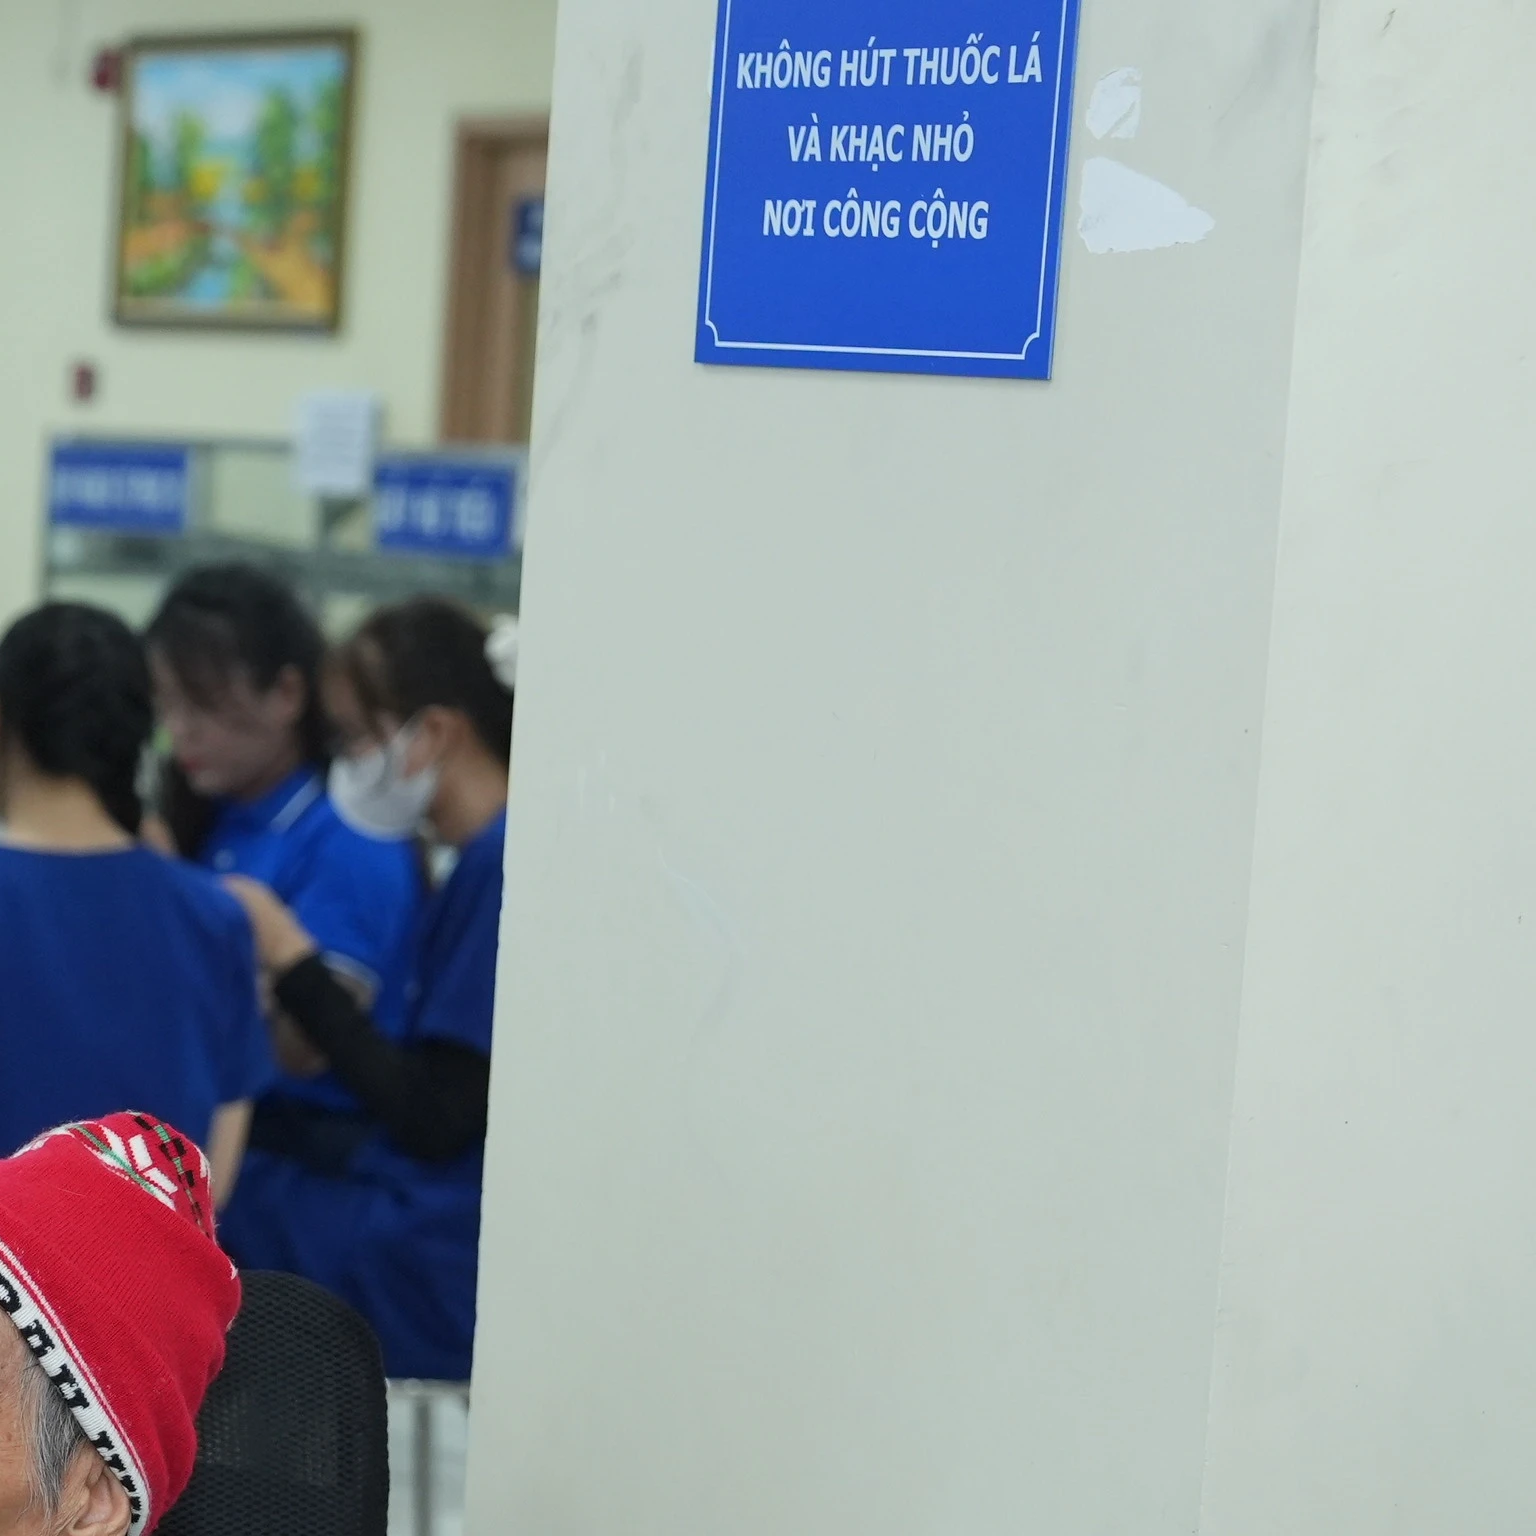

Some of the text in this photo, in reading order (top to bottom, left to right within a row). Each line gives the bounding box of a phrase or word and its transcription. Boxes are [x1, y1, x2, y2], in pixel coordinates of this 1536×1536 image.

[736, 31, 1044, 89] KHÔNG HÚT THUỐC LÁ
[788, 111, 975, 171] VÀ KHẠC NHỎ
[762, 188, 990, 248] NƠI CÔNG CỘNG
